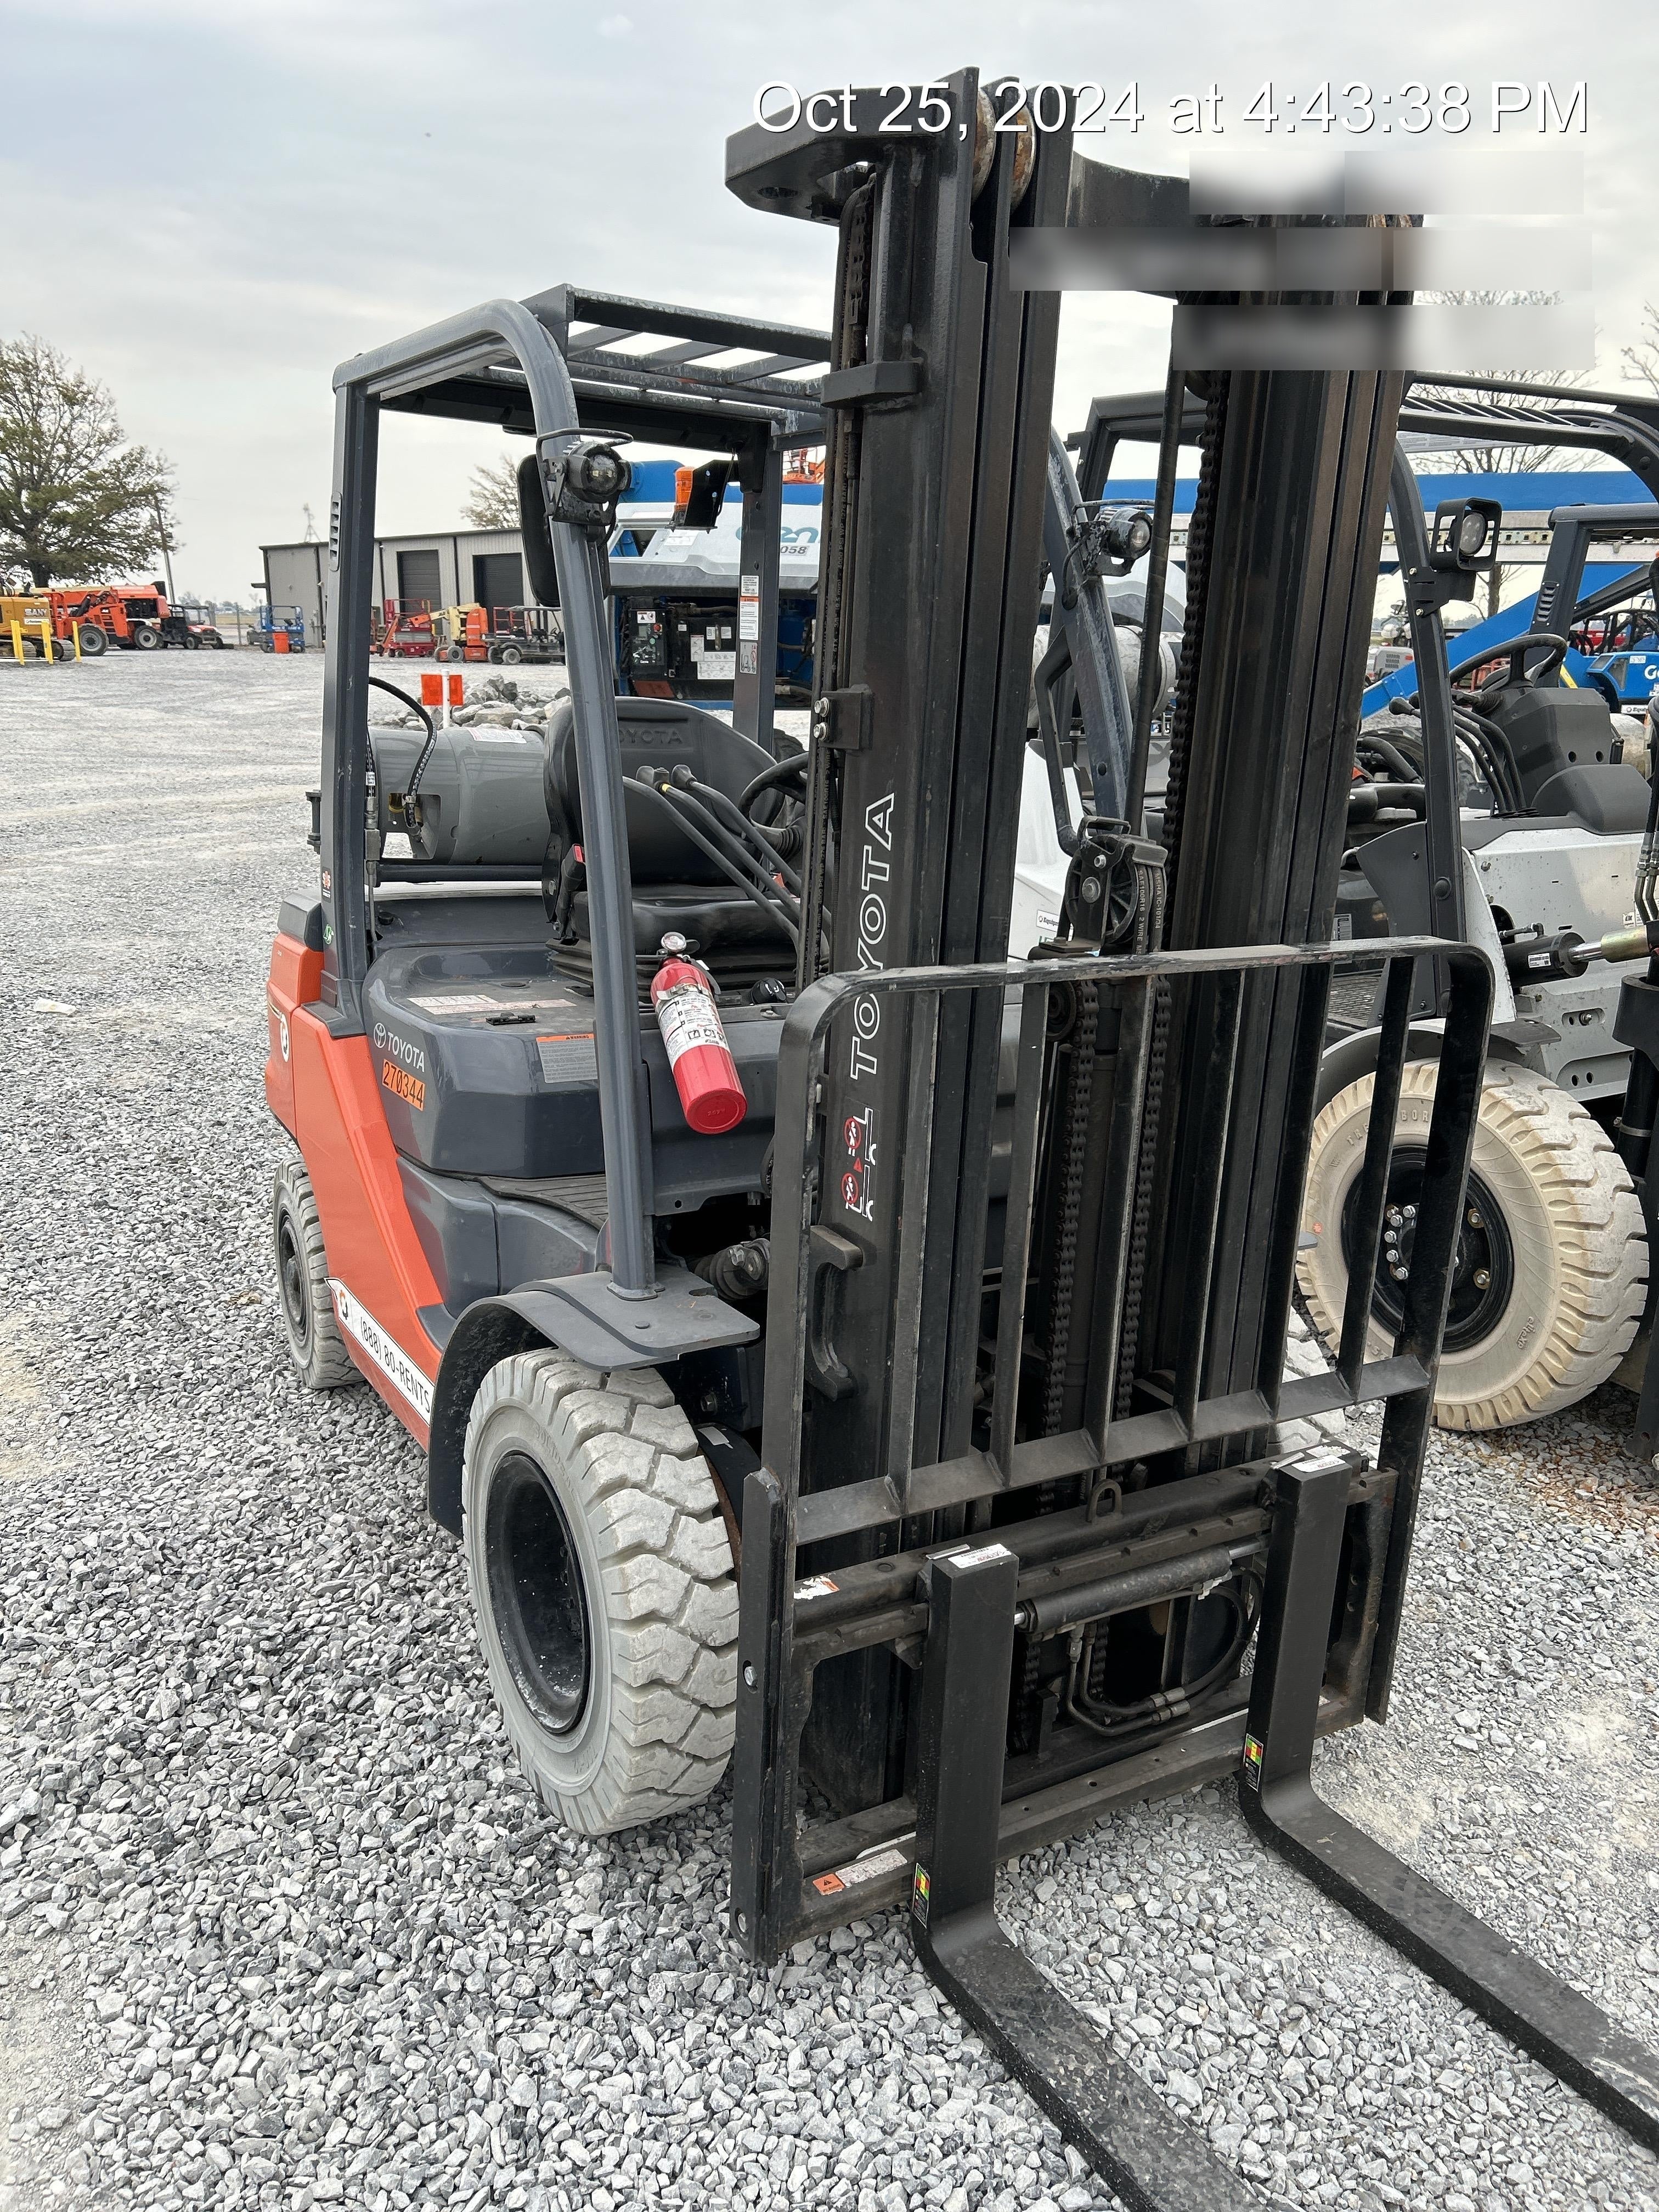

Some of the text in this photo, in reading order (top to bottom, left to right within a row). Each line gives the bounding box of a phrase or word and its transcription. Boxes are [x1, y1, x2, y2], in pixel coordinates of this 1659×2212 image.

[1137, 870, 1146, 911] SAE100R16
[850, 792, 895, 1080] TOYOTA
[387, 1031, 425, 1073] TOYOTA
[383, 1061, 424, 1108] 270344
[360, 1317, 430, 1413] (888) 80-RENTS
